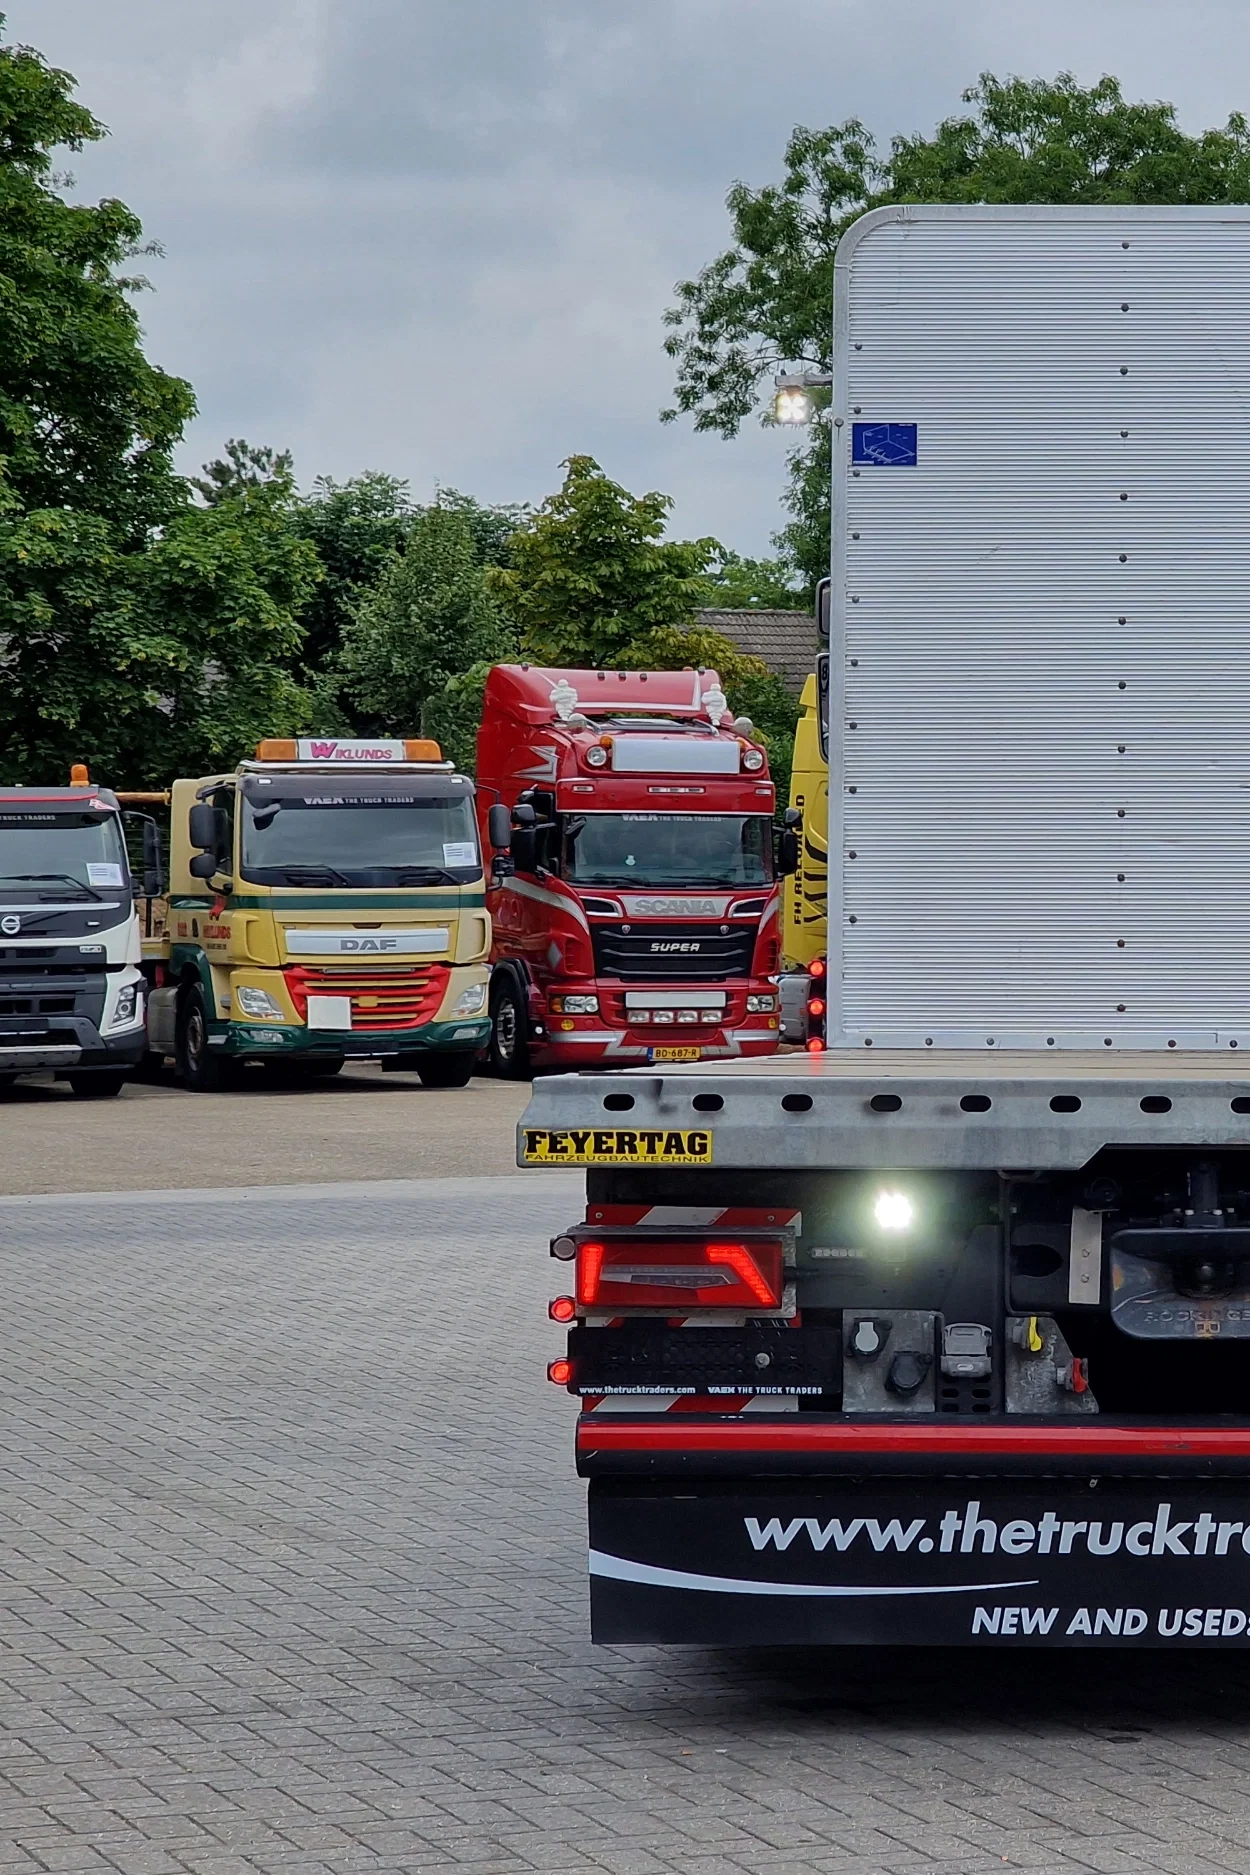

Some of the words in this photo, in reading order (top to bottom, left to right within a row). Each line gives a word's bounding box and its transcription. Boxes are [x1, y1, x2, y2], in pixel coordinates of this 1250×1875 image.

[634, 899, 718, 914] SCANIA
[340, 939, 397, 951] DAF
[650, 943, 701, 952] SUPER
[525, 1130, 708, 1156] FEYERTAG
[525, 1153, 709, 1163] FAHRZEUGBAUTECHNIK
[578, 1386, 696, 1395] www.thetrucktraders.com
[737, 1386, 753, 1394] THE
[755, 1386, 783, 1394] TRUCK
[785, 1386, 823, 1394] TRADERS
[971, 1607, 1060, 1636] NEW
[1065, 1608, 1149, 1637] AND
